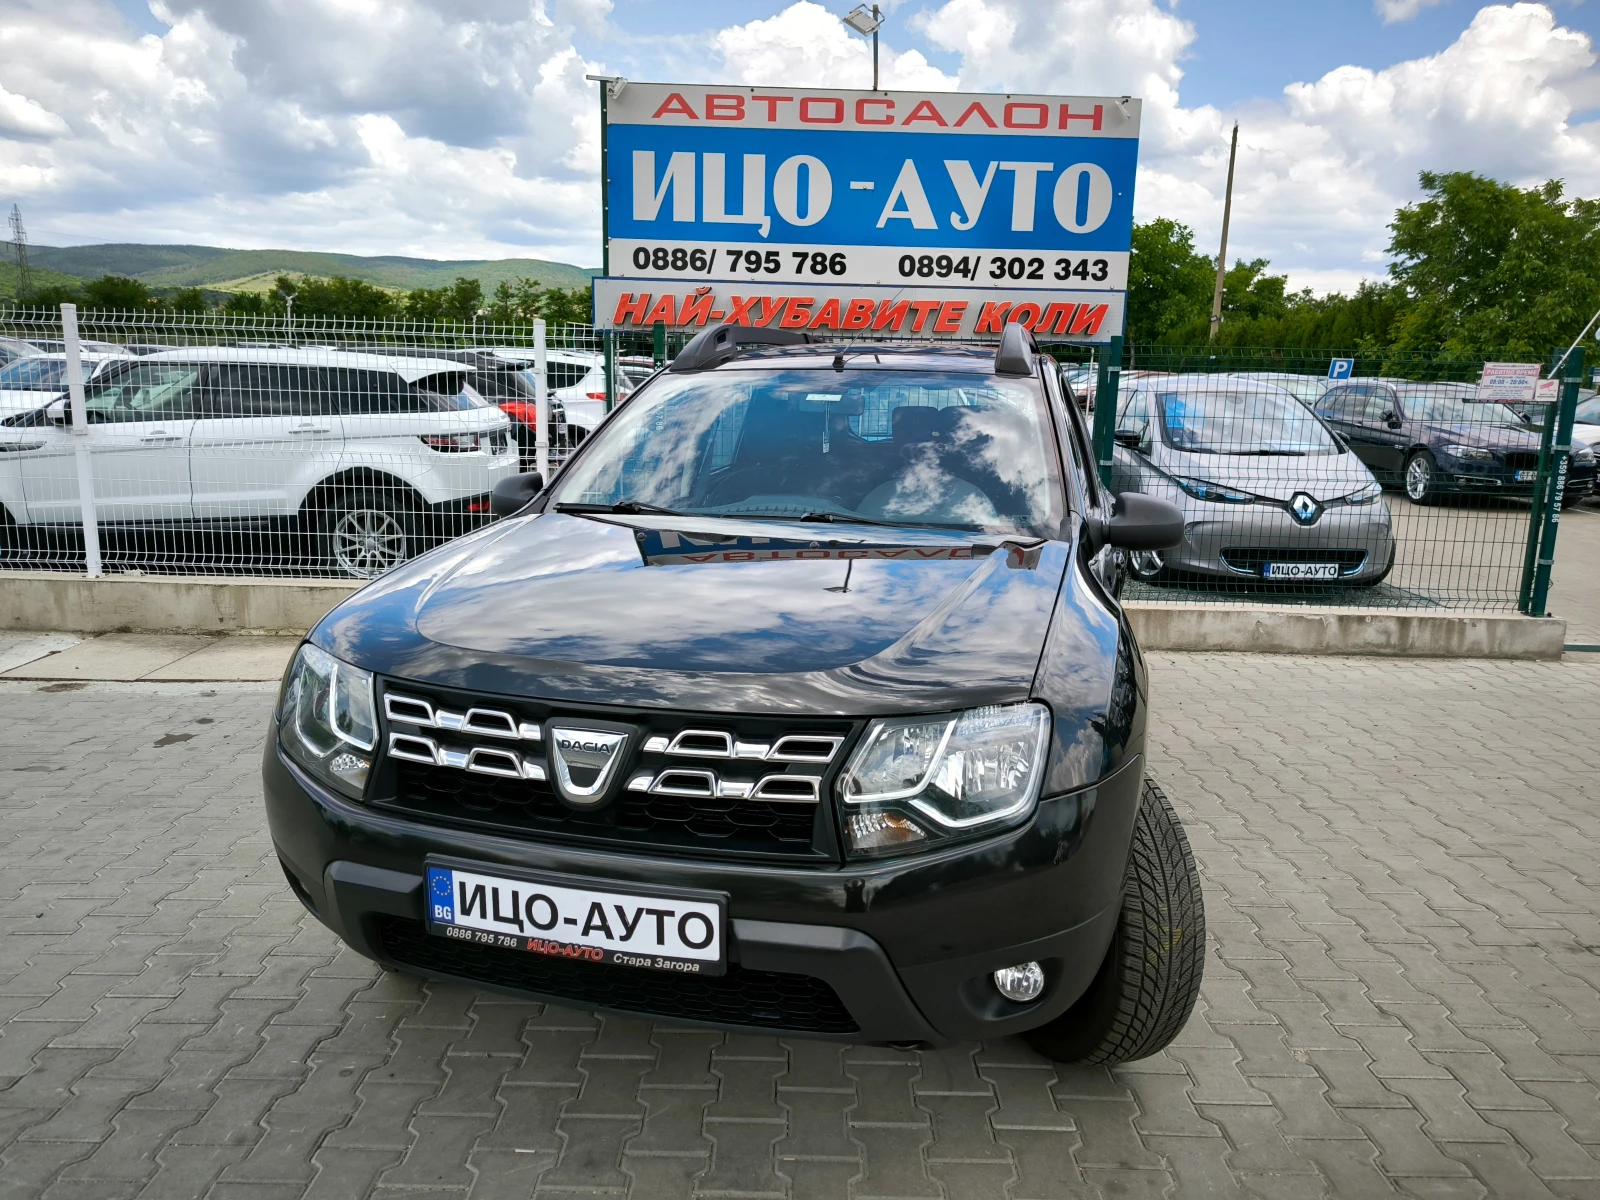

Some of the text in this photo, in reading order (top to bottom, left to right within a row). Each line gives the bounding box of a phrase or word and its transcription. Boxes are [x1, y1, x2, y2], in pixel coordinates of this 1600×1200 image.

[651, 92, 1104, 131] АВТОСАЛОН
[632, 246, 847, 276] 0886/ 795 786
[898, 254, 1109, 282] 0894/ 302 343
[611, 286, 1110, 335] НАЙ-ХУБАВИТЕ КОЛИ
[1333, 361, 1348, 378] P
[1556, 476, 1566, 490] 886
[1551, 513, 1560, 523] 86
[1271, 565, 1337, 577] ИЦО-АУТО
[561, 739, 611, 754] DACIA
[434, 904, 452, 920] BG
[458, 880, 715, 950] ИЦО-АУТО
[446, 927, 518, 947] 0886 795 786
[526, 937, 604, 961] ИЦО-АУТО
[613, 953, 700, 972] Стара Загора
